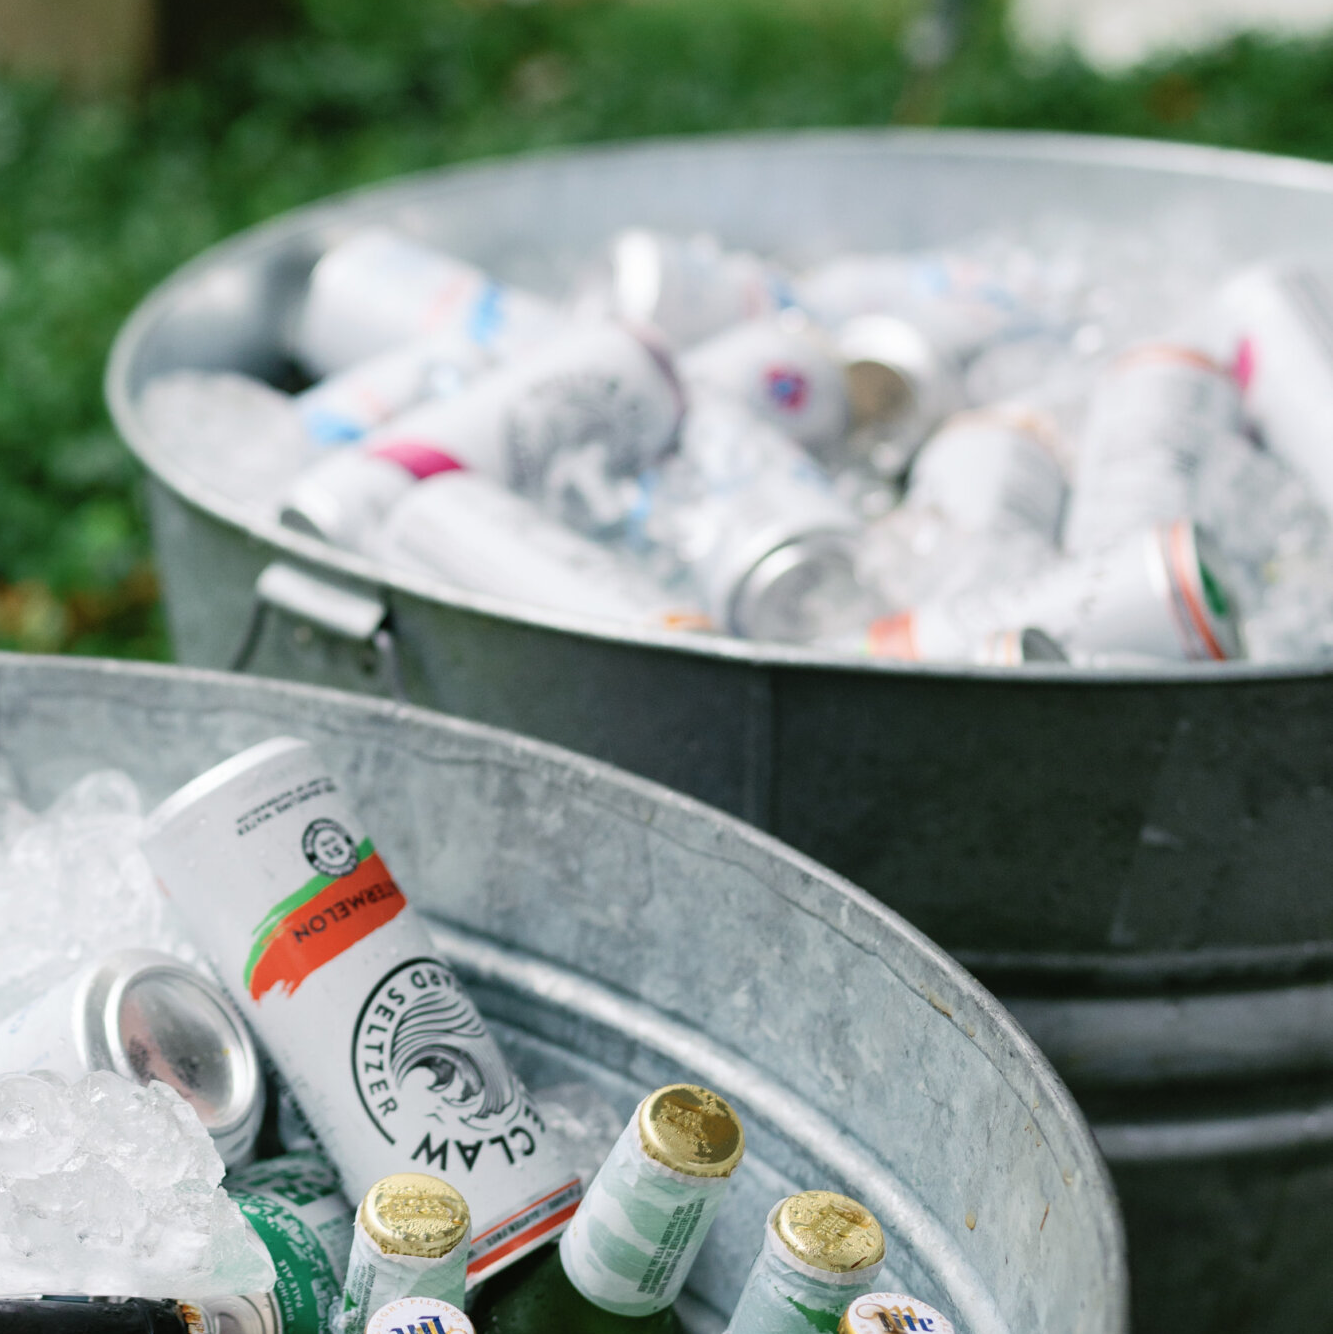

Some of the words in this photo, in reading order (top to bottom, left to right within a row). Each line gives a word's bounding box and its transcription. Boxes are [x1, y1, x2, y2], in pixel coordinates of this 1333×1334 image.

[293, 879, 399, 944] TERMELON
[364, 987, 406, 1117] SELTZER
[411, 1125, 536, 1173] CLAW
[276, 1257, 294, 1280] ALE
[287, 1280, 305, 1308] PALE
